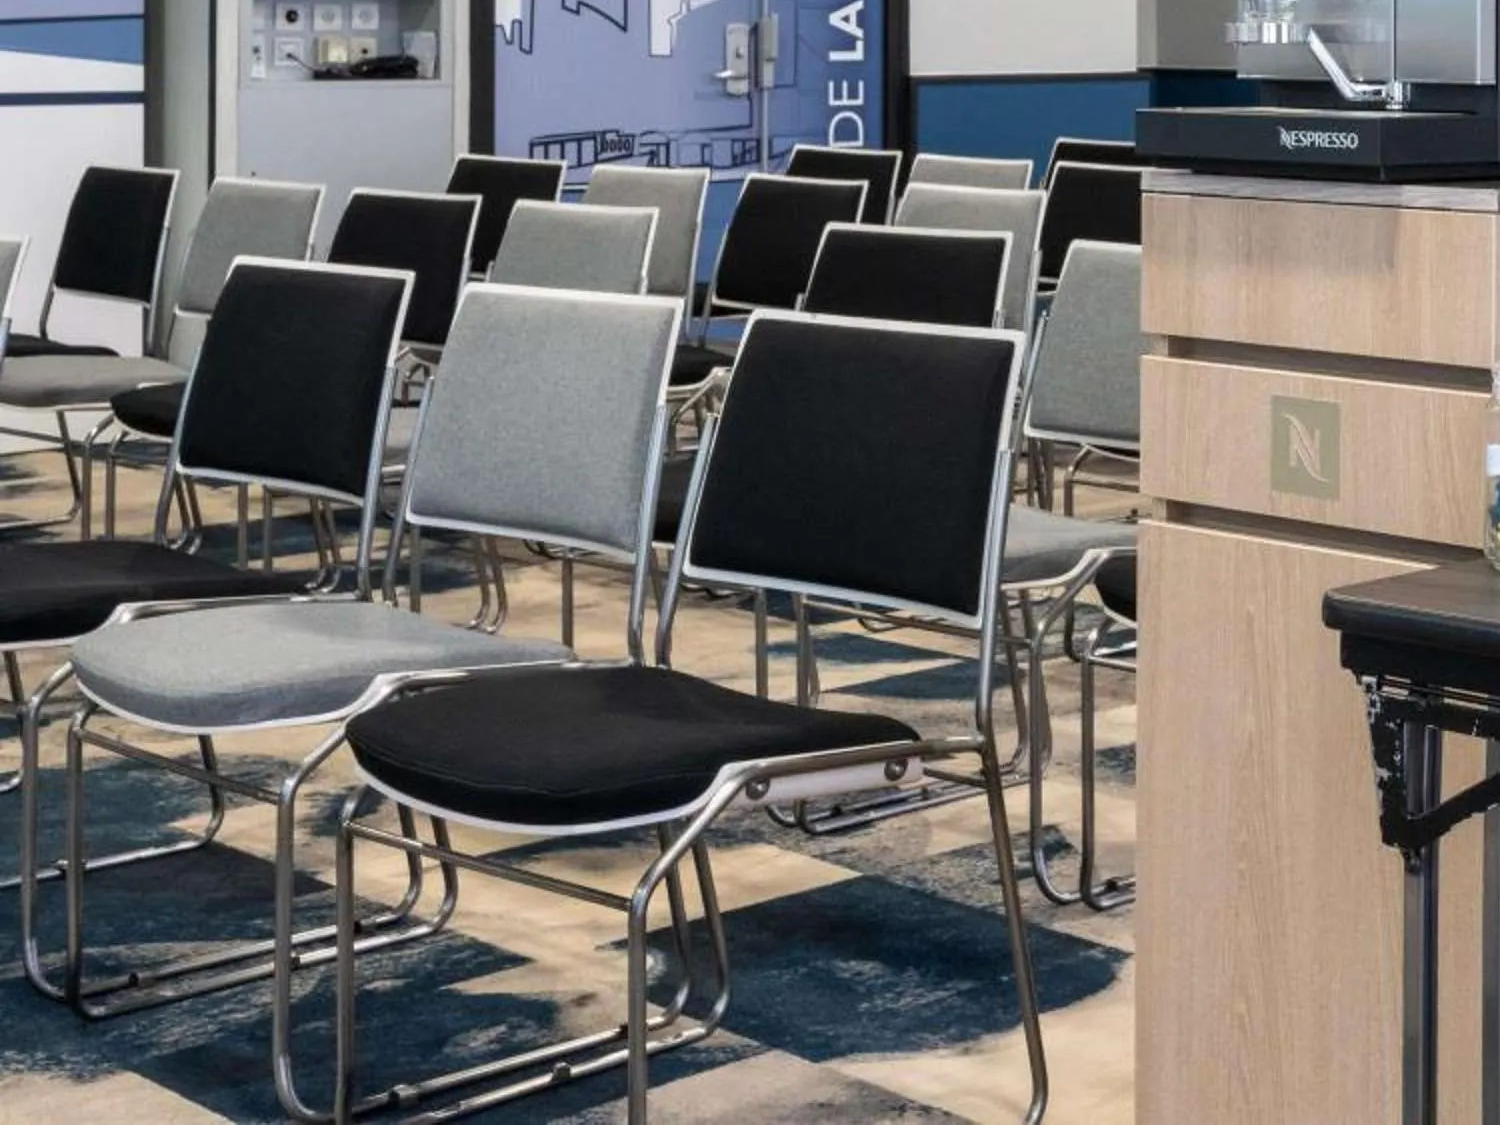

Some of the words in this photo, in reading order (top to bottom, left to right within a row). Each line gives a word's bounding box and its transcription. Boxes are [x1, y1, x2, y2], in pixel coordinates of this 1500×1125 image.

[829, 0, 864, 62] LA
[828, 80, 864, 148] DE
[1277, 125, 1359, 150] NESPRESSO
